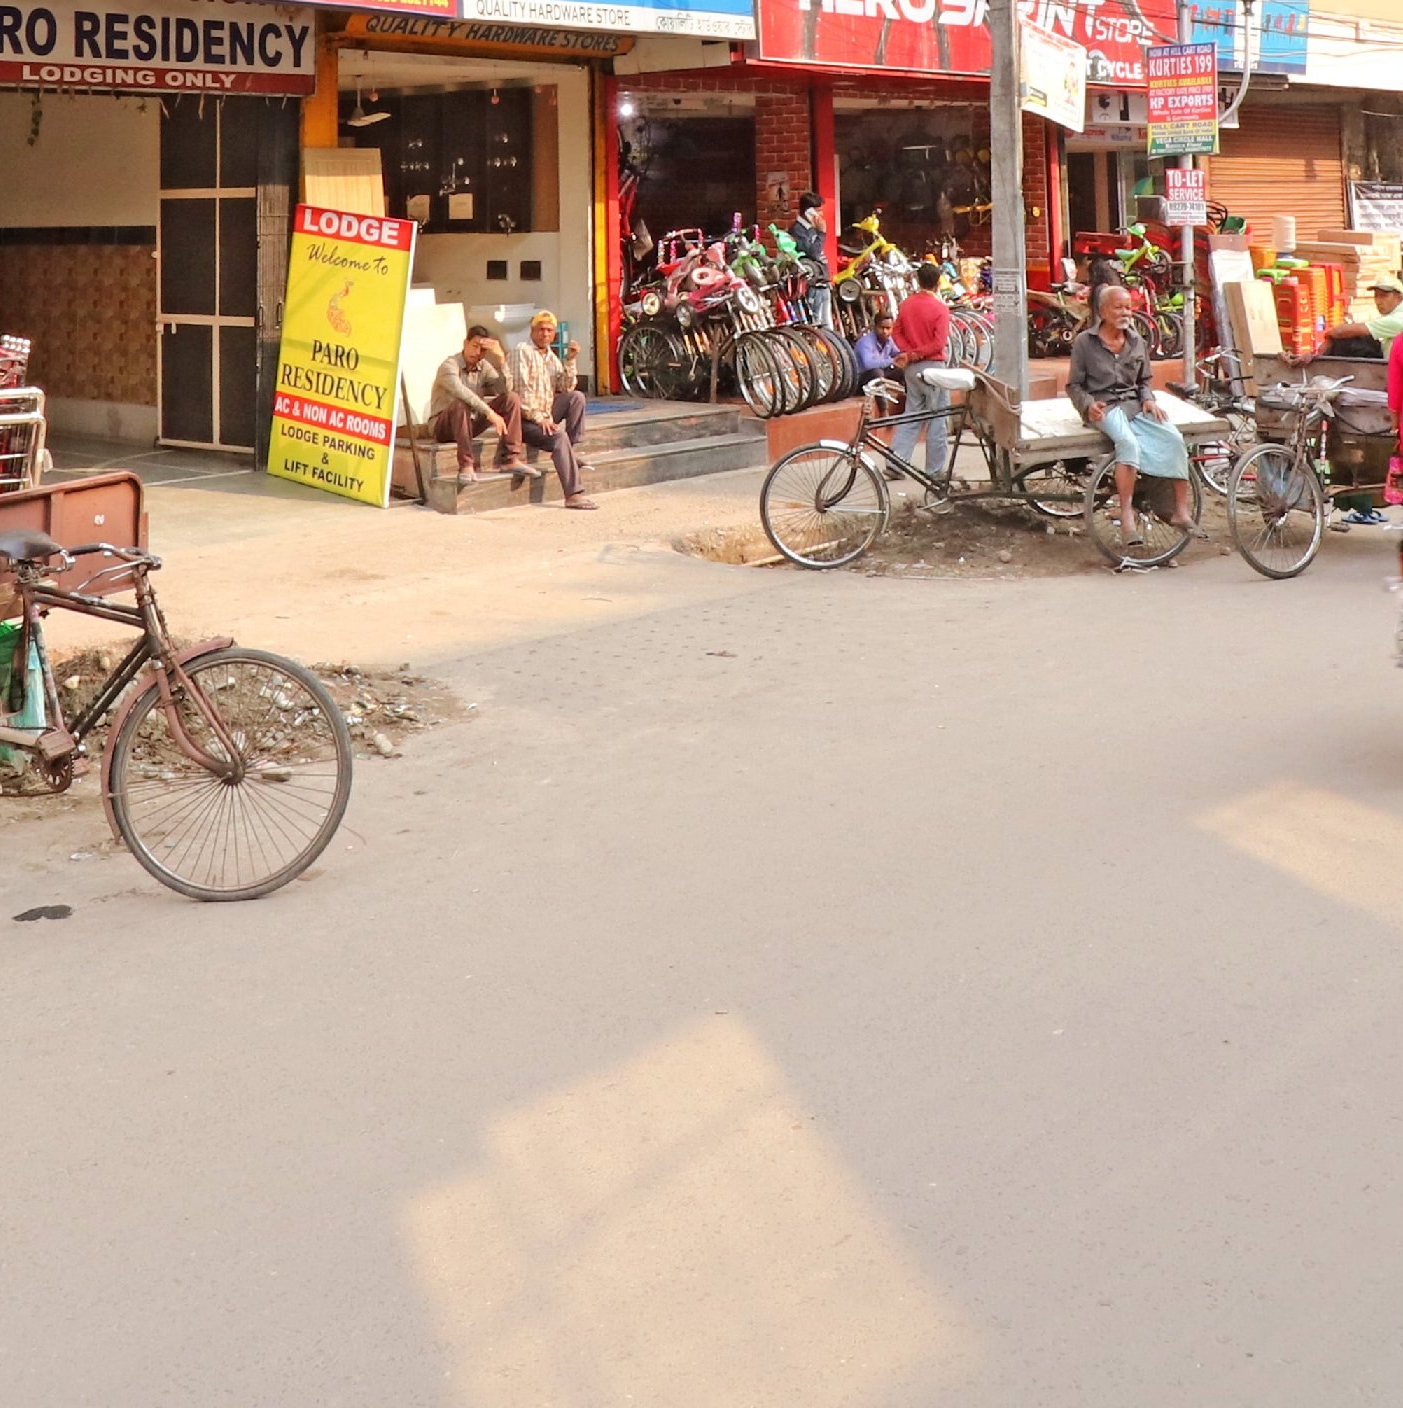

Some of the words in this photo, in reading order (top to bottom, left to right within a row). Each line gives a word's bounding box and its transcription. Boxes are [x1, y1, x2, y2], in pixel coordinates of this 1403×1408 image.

[528, 2, 594, 25] HARDWARE
[596, 8, 631, 27] STORE
[74, 10, 310, 68] RESIDENCY
[365, 15, 466, 39] QUALITY
[465, 19, 558, 48] HARDWARE
[559, 32, 620, 54] STORES
[1096, 16, 1154, 46] STORE
[22, 64, 158, 85] LODGING
[164, 70, 237, 89] ONLY
[1097, 59, 1144, 80] CYCLE
[1149, 56, 1193, 76] KURTIES
[1194, 54, 1213, 73] 199
[1168, 94, 1214, 108] EXPORTS
[1166, 170, 1205, 187] TO-LET
[1168, 188, 1204, 201] SERVICE
[303, 208, 400, 245] LODGE
[306, 242, 372, 271] Welcome
[373, 256, 389, 275] to
[311, 339, 359, 371] PARO
[280, 363, 388, 410] RESIDENCY
[275, 395, 290, 413] AC
[292, 400, 301, 416] &
[303, 403, 326, 423] NON
[329, 409, 345, 428] AC
[346, 414, 386, 440] ROOMS
[281, 423, 319, 445] LODGE
[322, 434, 376, 461] PARKING
[321, 451, 330, 466] &
[284, 458, 309, 475] LIFT
[312, 466, 365, 492] FACILITY
